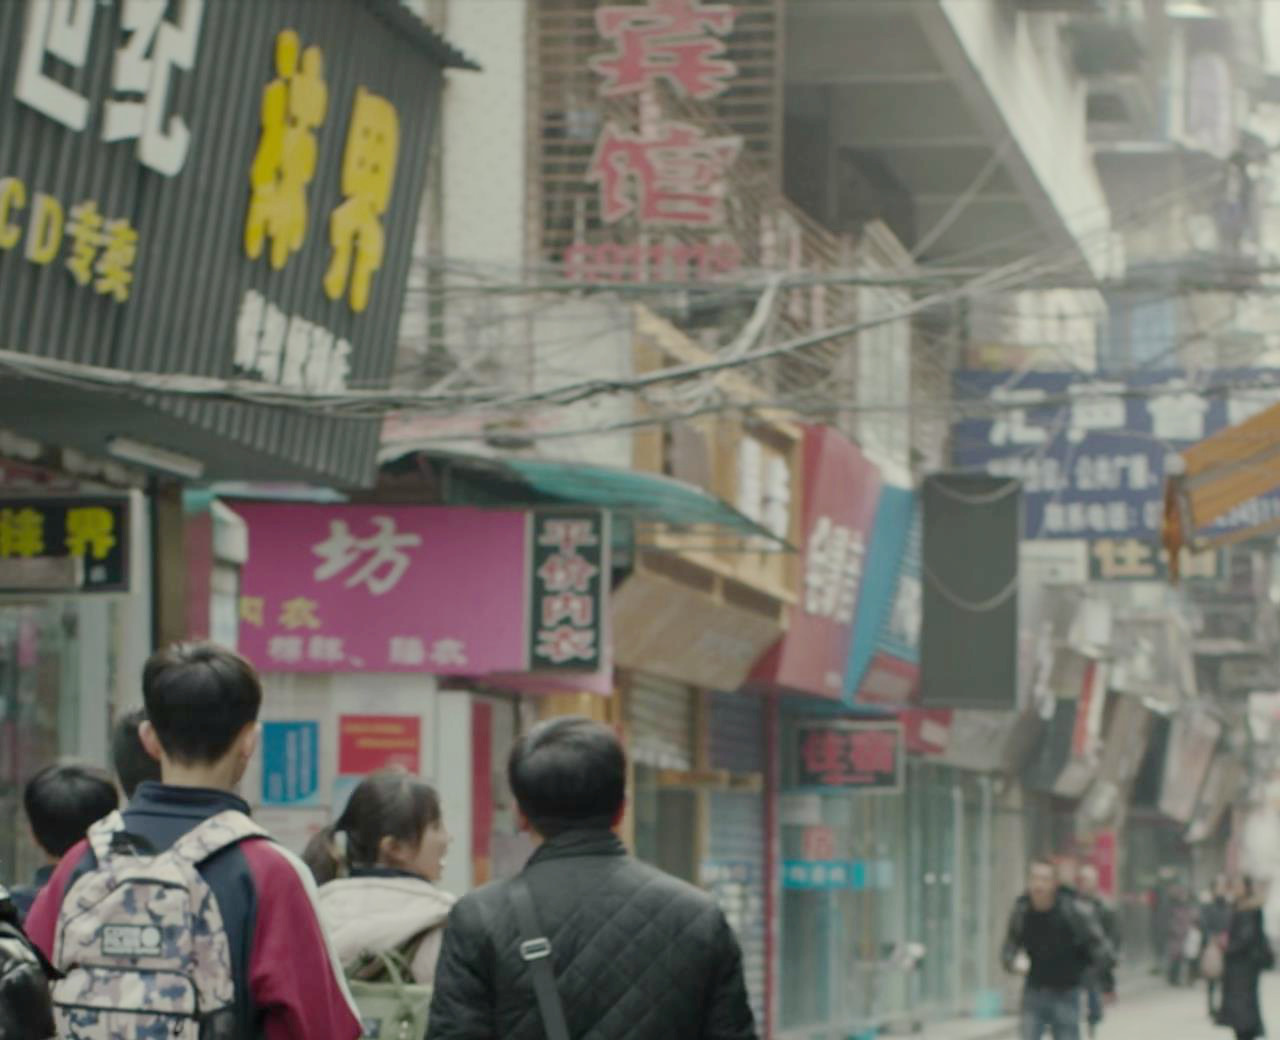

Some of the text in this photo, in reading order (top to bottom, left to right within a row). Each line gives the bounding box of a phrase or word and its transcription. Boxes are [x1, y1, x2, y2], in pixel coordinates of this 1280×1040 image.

[310, 515, 423, 596] 坊
[535, 518, 600, 664] 平价内衣
